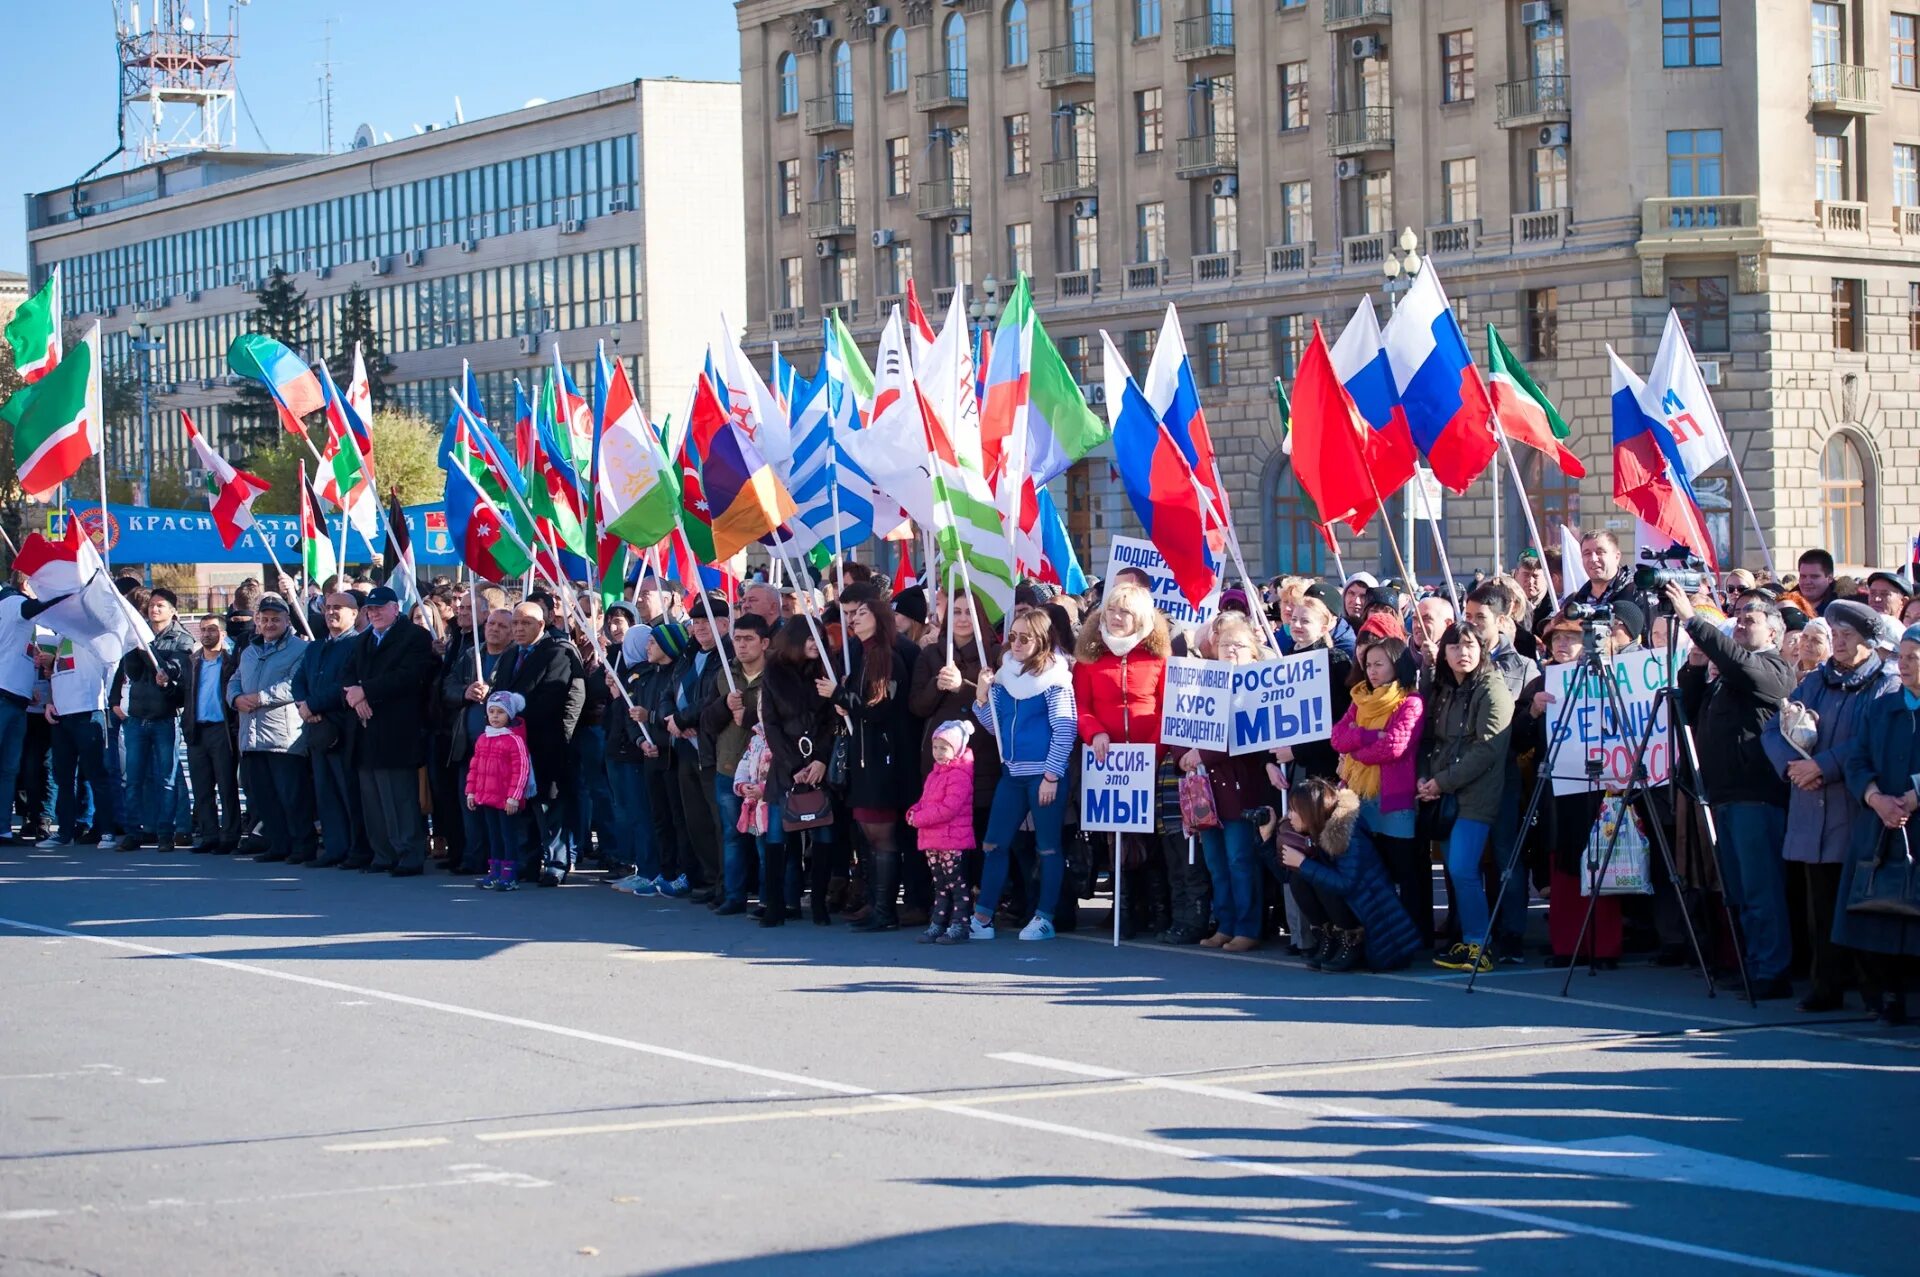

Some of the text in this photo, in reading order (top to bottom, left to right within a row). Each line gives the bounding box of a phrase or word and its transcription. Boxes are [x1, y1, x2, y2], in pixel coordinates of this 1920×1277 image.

[1167, 665, 1230, 690] ПОДДЕРЖИВАЕМ
[1232, 659, 1322, 695] РОССИЯ-
[1176, 693, 1216, 717] КУРС
[1261, 686, 1295, 703] это
[1164, 716, 1225, 743] ПРЕЗИДЕНТА!
[1235, 696, 1323, 747] МЫ!
[1105, 774, 1130, 785] это
[1086, 788, 1149, 824] МЫ!
